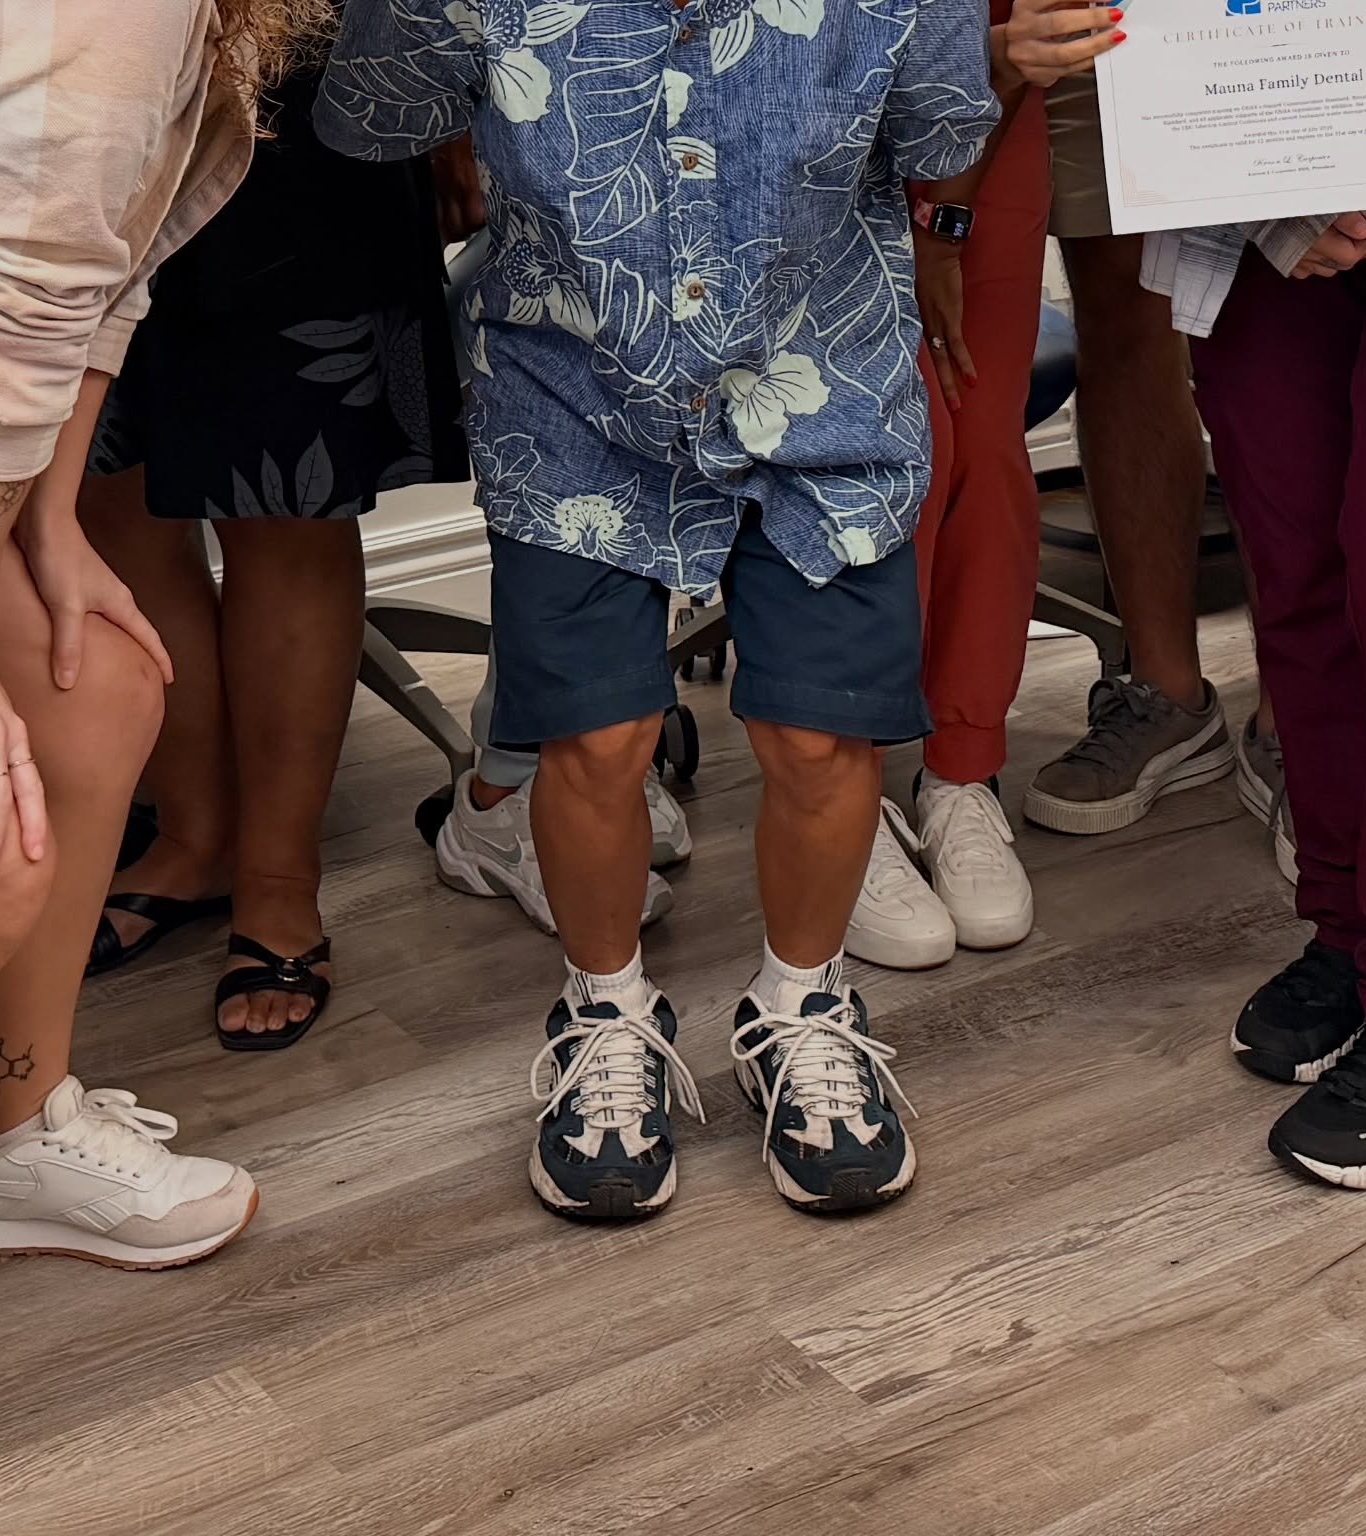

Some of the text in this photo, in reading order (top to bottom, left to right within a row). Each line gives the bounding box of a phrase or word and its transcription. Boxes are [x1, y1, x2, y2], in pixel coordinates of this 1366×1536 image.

[1163, 23, 1276, 44] CERTIFICATE
[1284, 20, 1305, 33] OF
[1205, 69, 1364, 96] Mauna Family Dental
